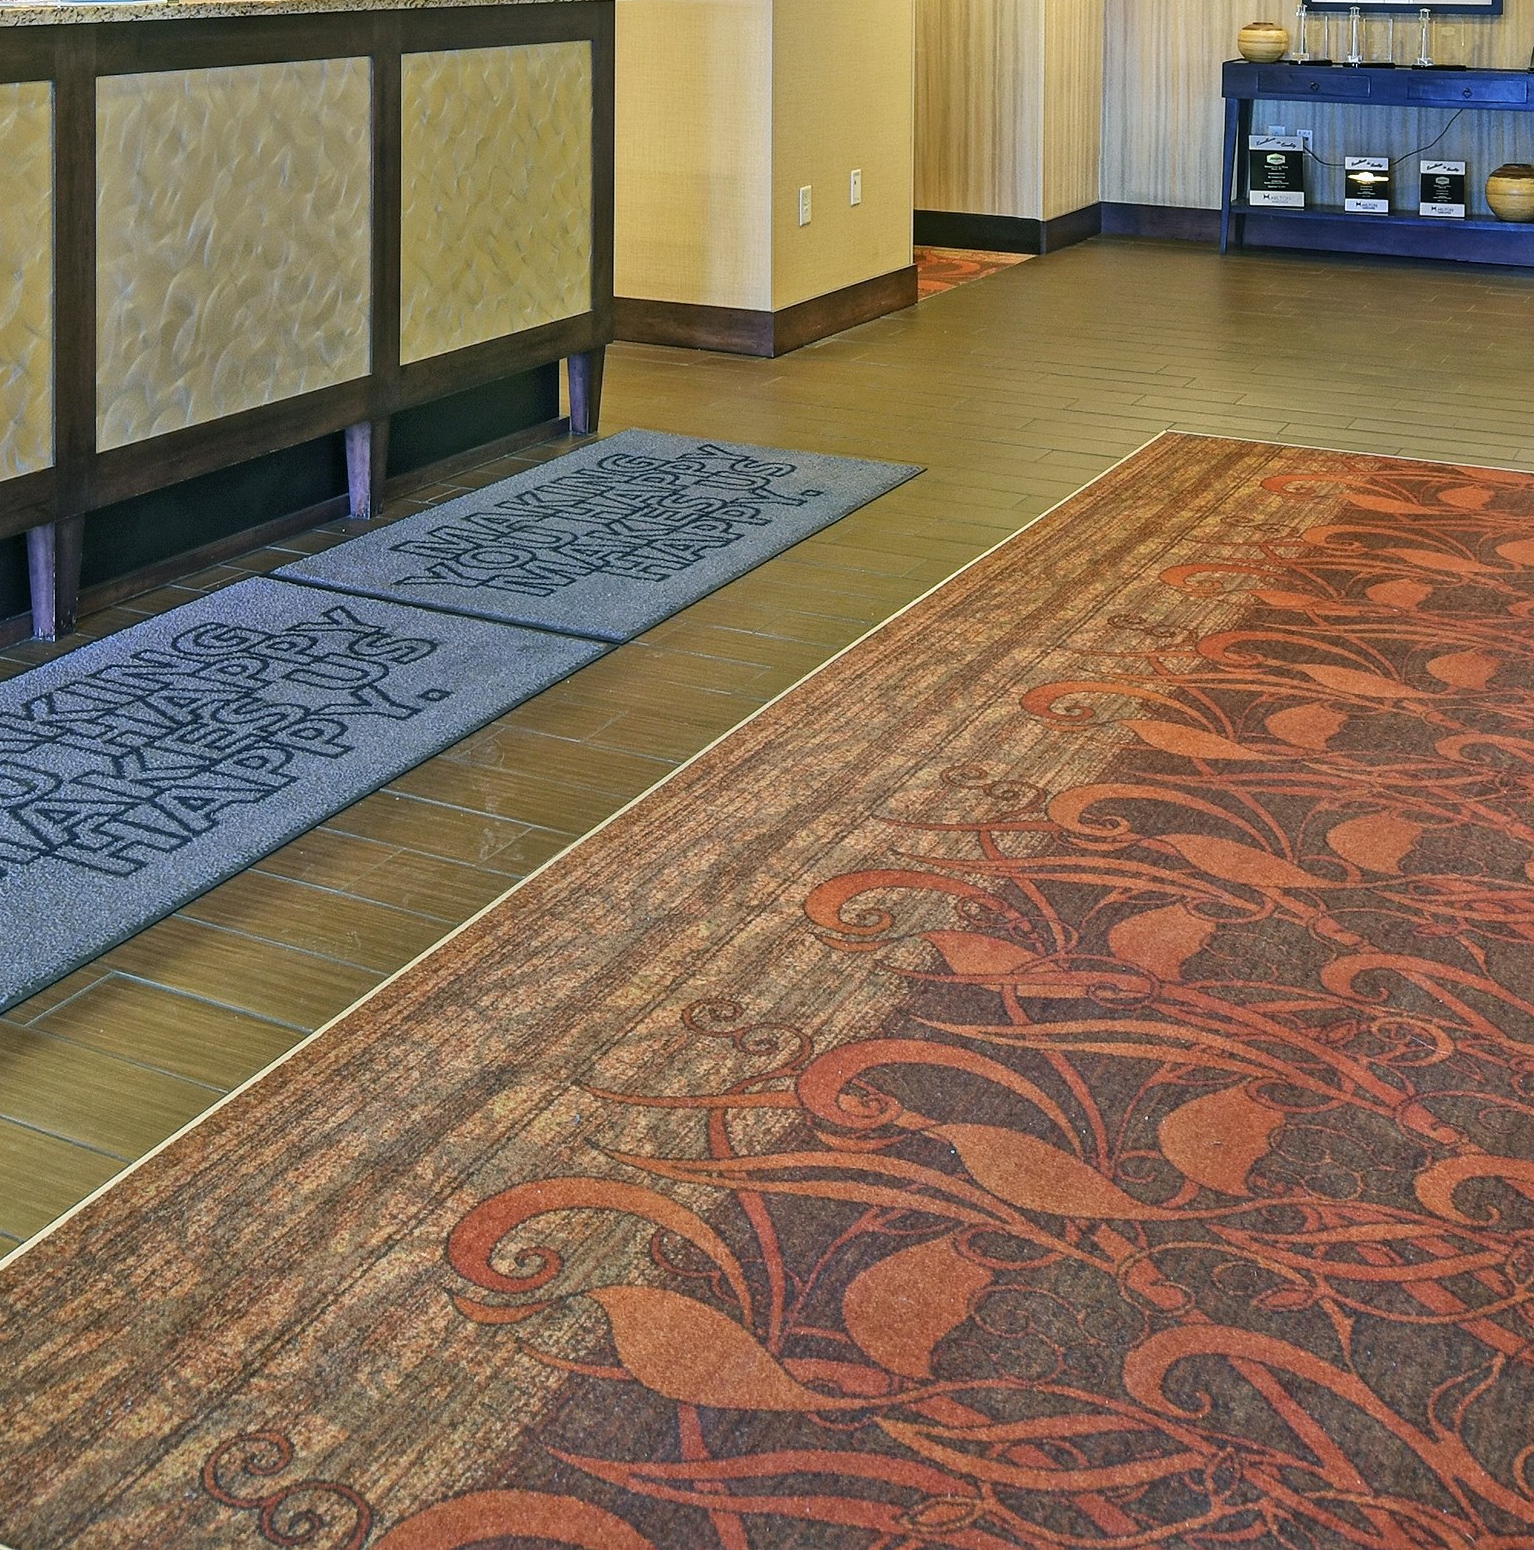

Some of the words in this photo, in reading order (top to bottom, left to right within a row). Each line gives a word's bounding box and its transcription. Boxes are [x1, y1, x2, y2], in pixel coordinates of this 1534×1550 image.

[388, 453, 669, 561] MAKING
[391, 525, 579, 588] YOU
[551, 443, 750, 526] HAPPY
[481, 497, 729, 597] MAKES
[694, 459, 798, 491] US
[599, 486, 825, 582] HAPPY.
[44, 606, 387, 750] HAPPY
[280, 634, 438, 690] US
[49, 684, 454, 877] HAPPY.
